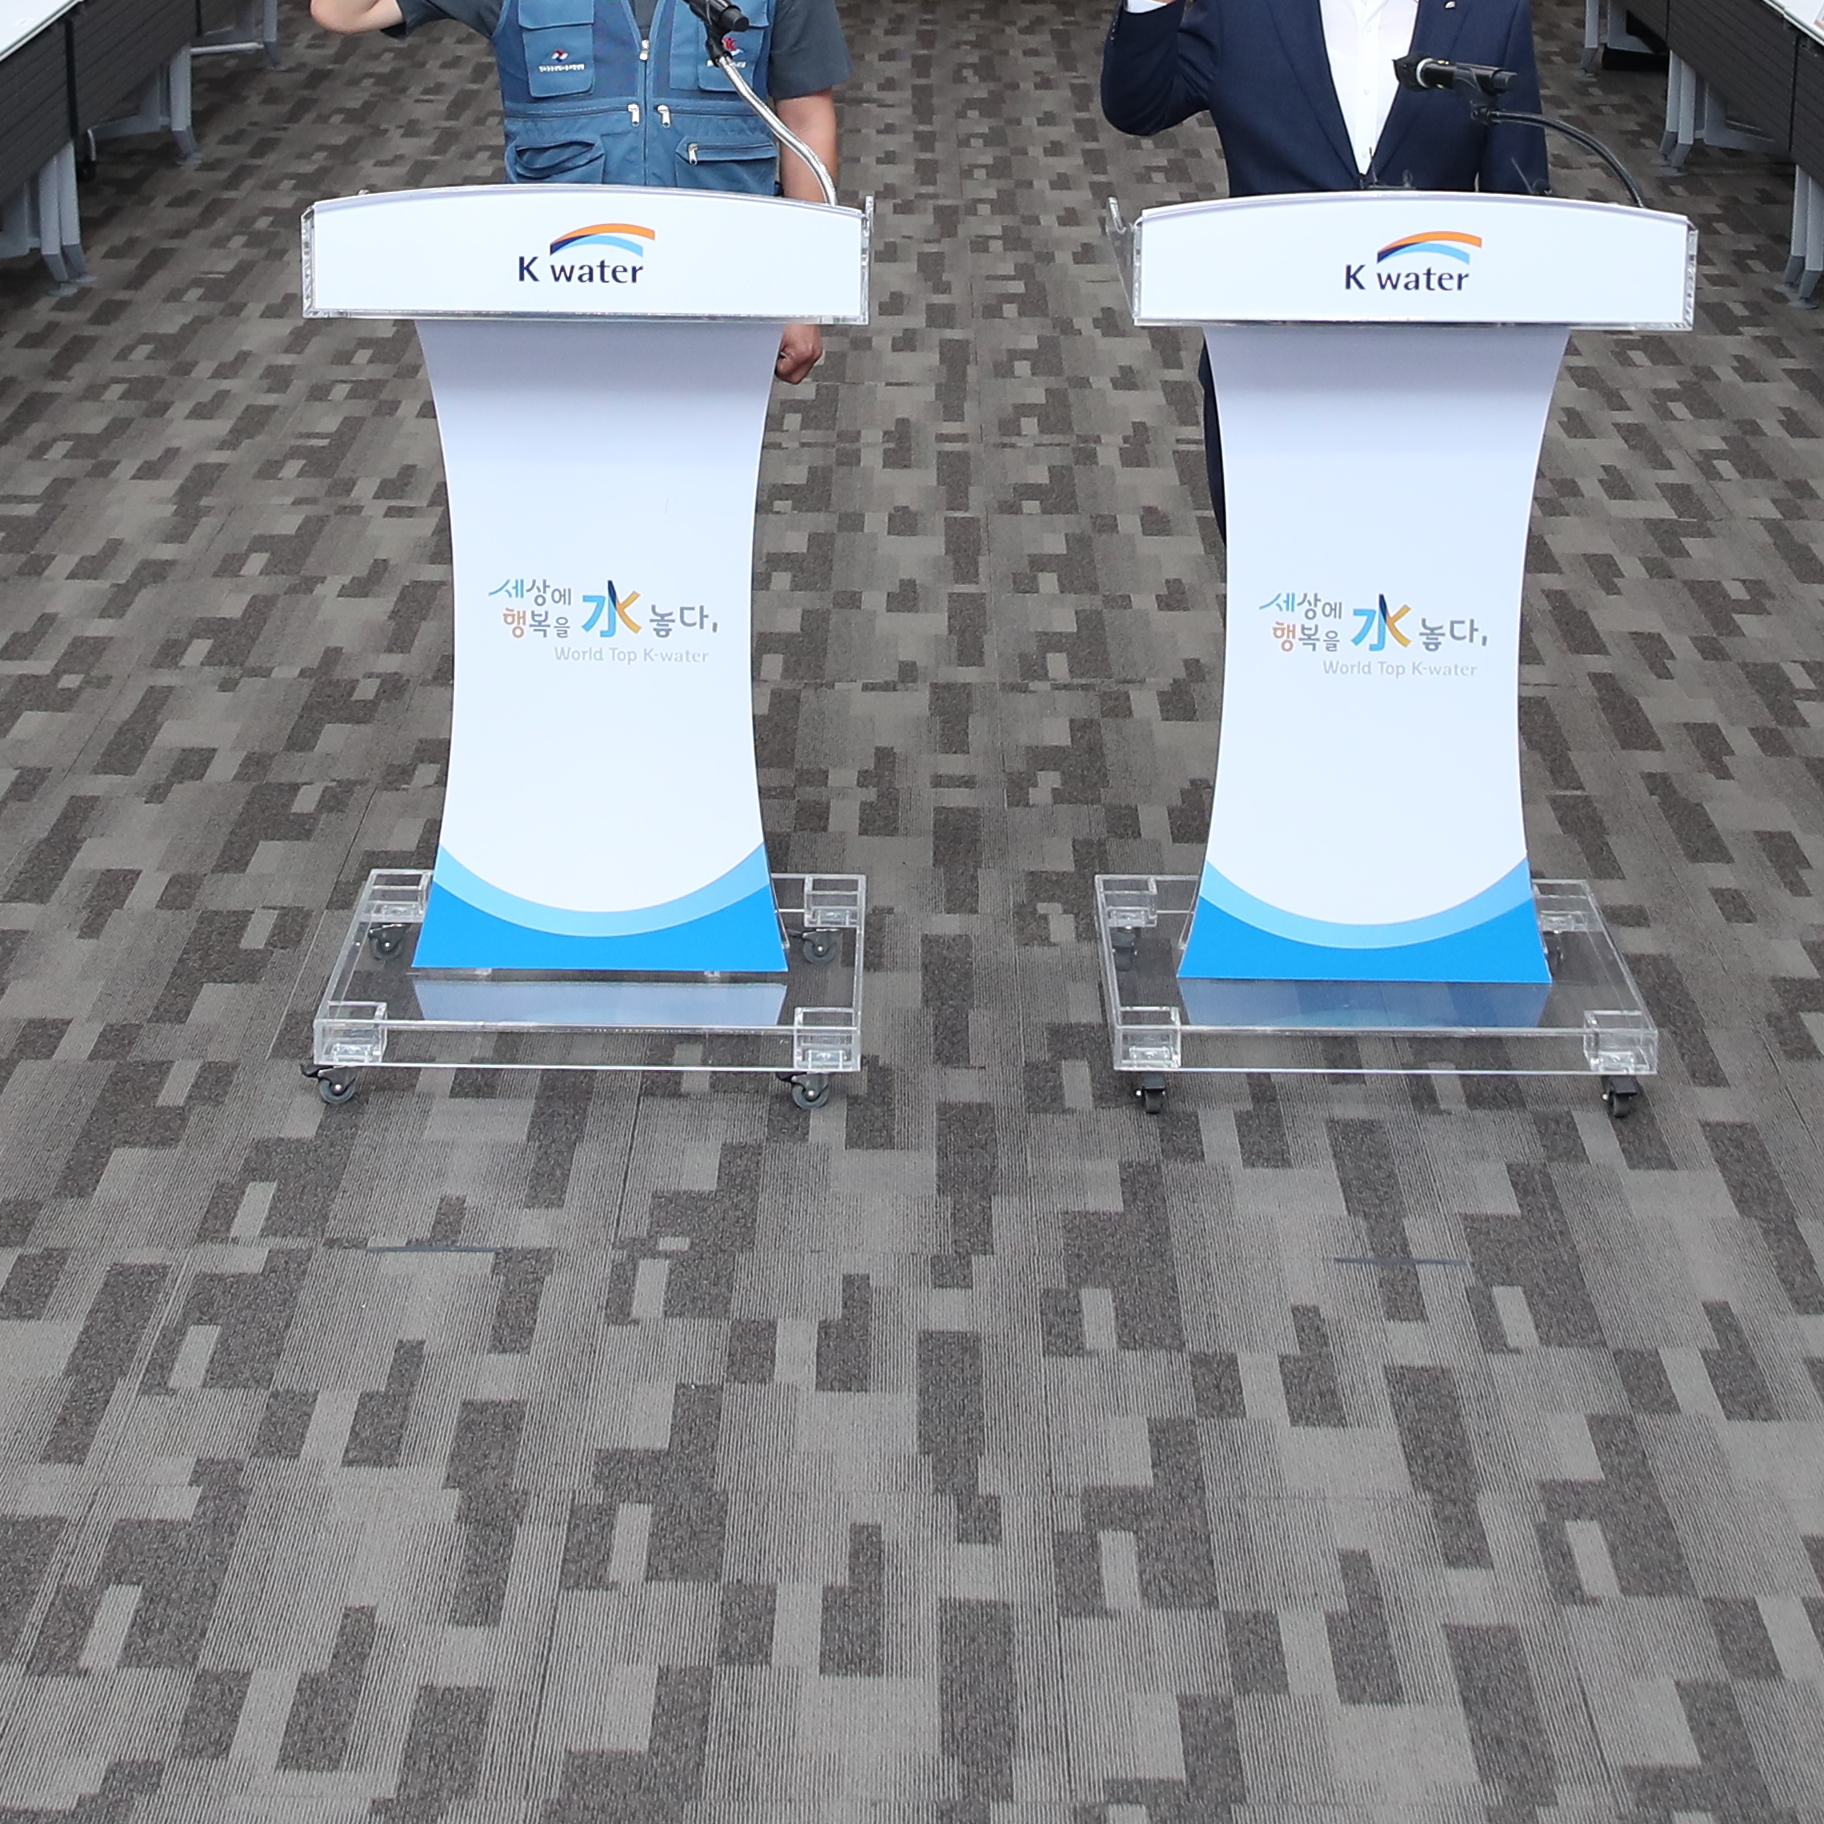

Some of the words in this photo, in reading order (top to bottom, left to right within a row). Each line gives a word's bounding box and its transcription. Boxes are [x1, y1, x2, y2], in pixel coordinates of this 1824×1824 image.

[518, 255, 540, 283] K
[551, 259, 643, 285] water
[1345, 265, 1366, 290] K
[1376, 268, 1469, 293] water
[488, 578, 573, 607] 세상에
[1259, 592, 1343, 623] 세상에
[502, 607, 571, 639] 행복을
[1272, 621, 1341, 653] 행복을
[554, 646, 605, 662] World
[609, 647, 638, 665] Top
[643, 647, 710, 664] K-water
[1322, 660, 1373, 677] World
[1377, 661, 1407, 681] Top
[1411, 661, 1478, 678] K-water
